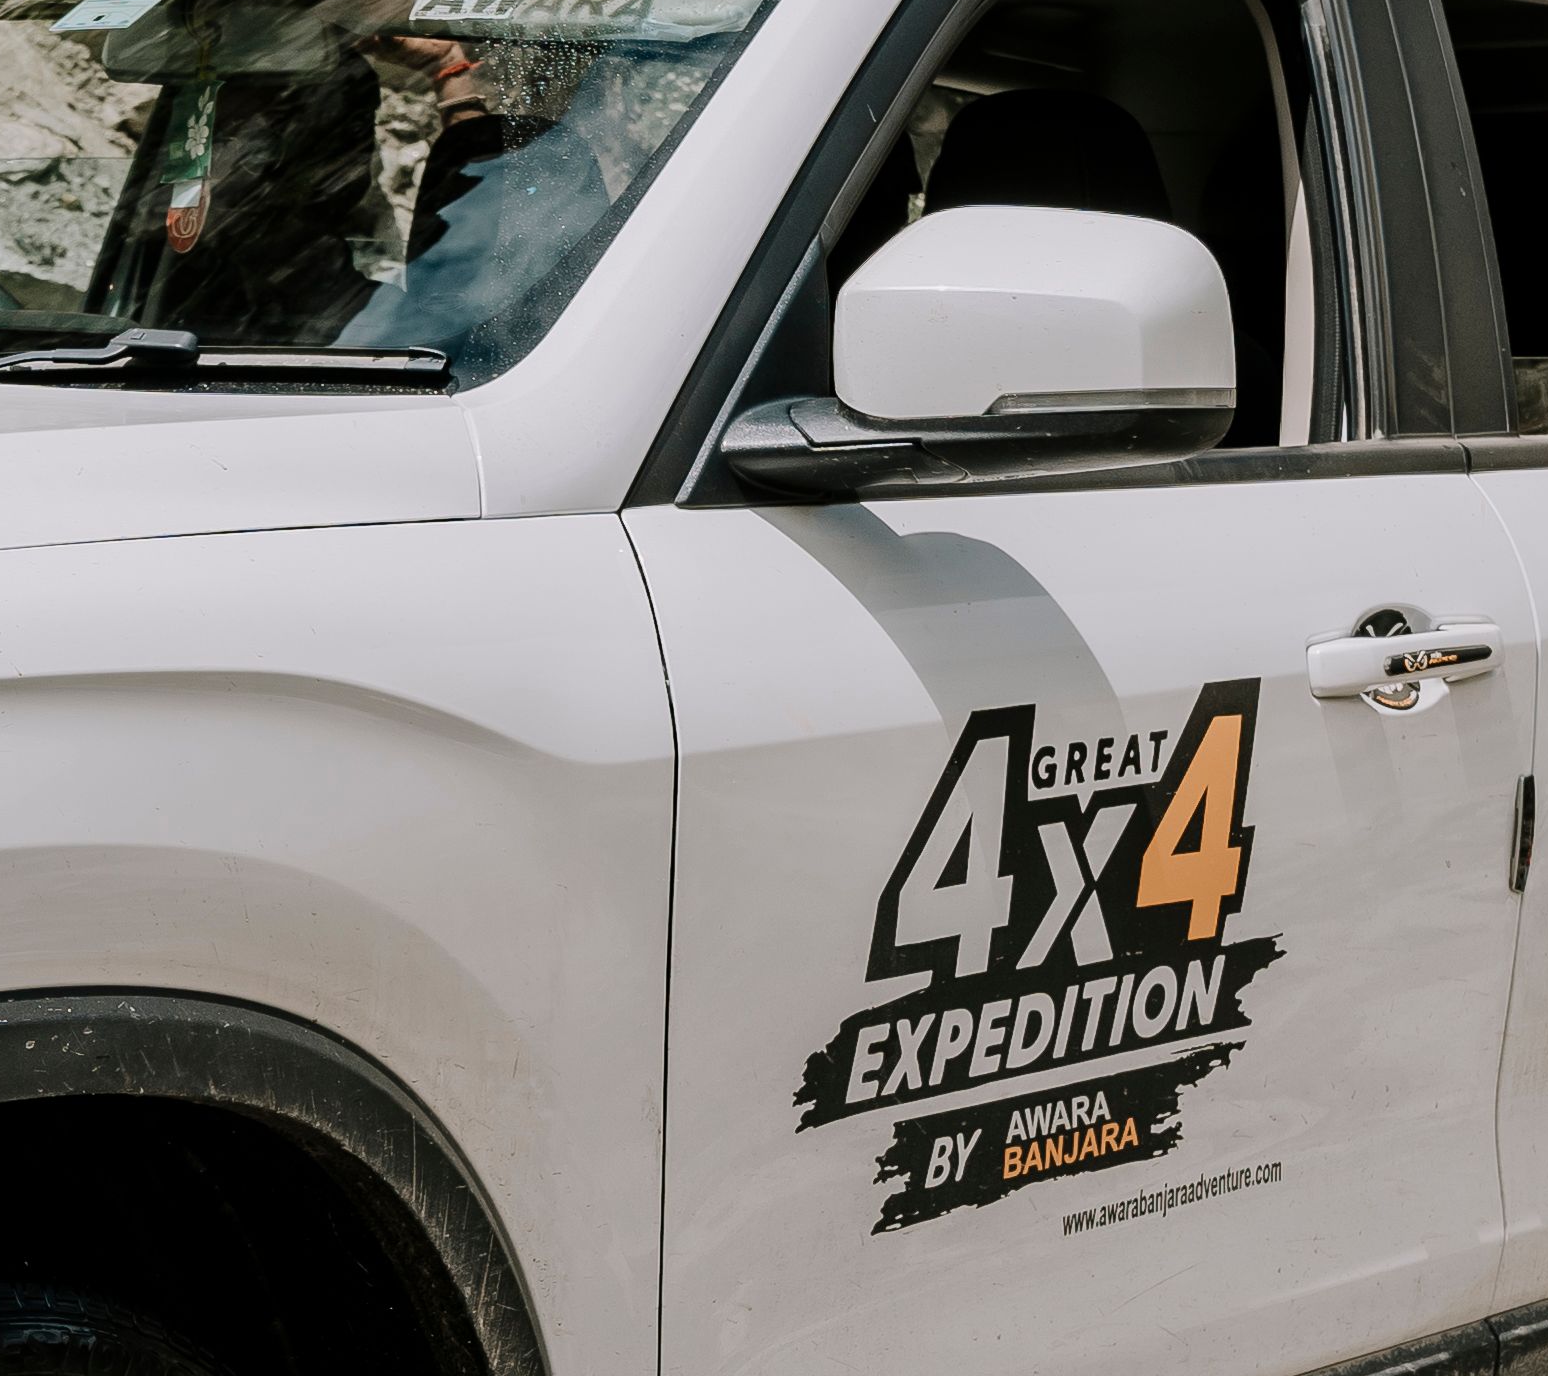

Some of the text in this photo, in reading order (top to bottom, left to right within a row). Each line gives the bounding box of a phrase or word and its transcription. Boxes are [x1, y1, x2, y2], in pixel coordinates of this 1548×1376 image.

[1031, 729, 1169, 790] GREAT
[845, 954, 1226, 1105] EXPEDITION
[1002, 1117, 1140, 1180] BANJARA
[1005, 1090, 1112, 1145] AWARA
[923, 1128, 983, 1190] BY
[1062, 1161, 1283, 1237] www.awarabanjaraadventure.com
